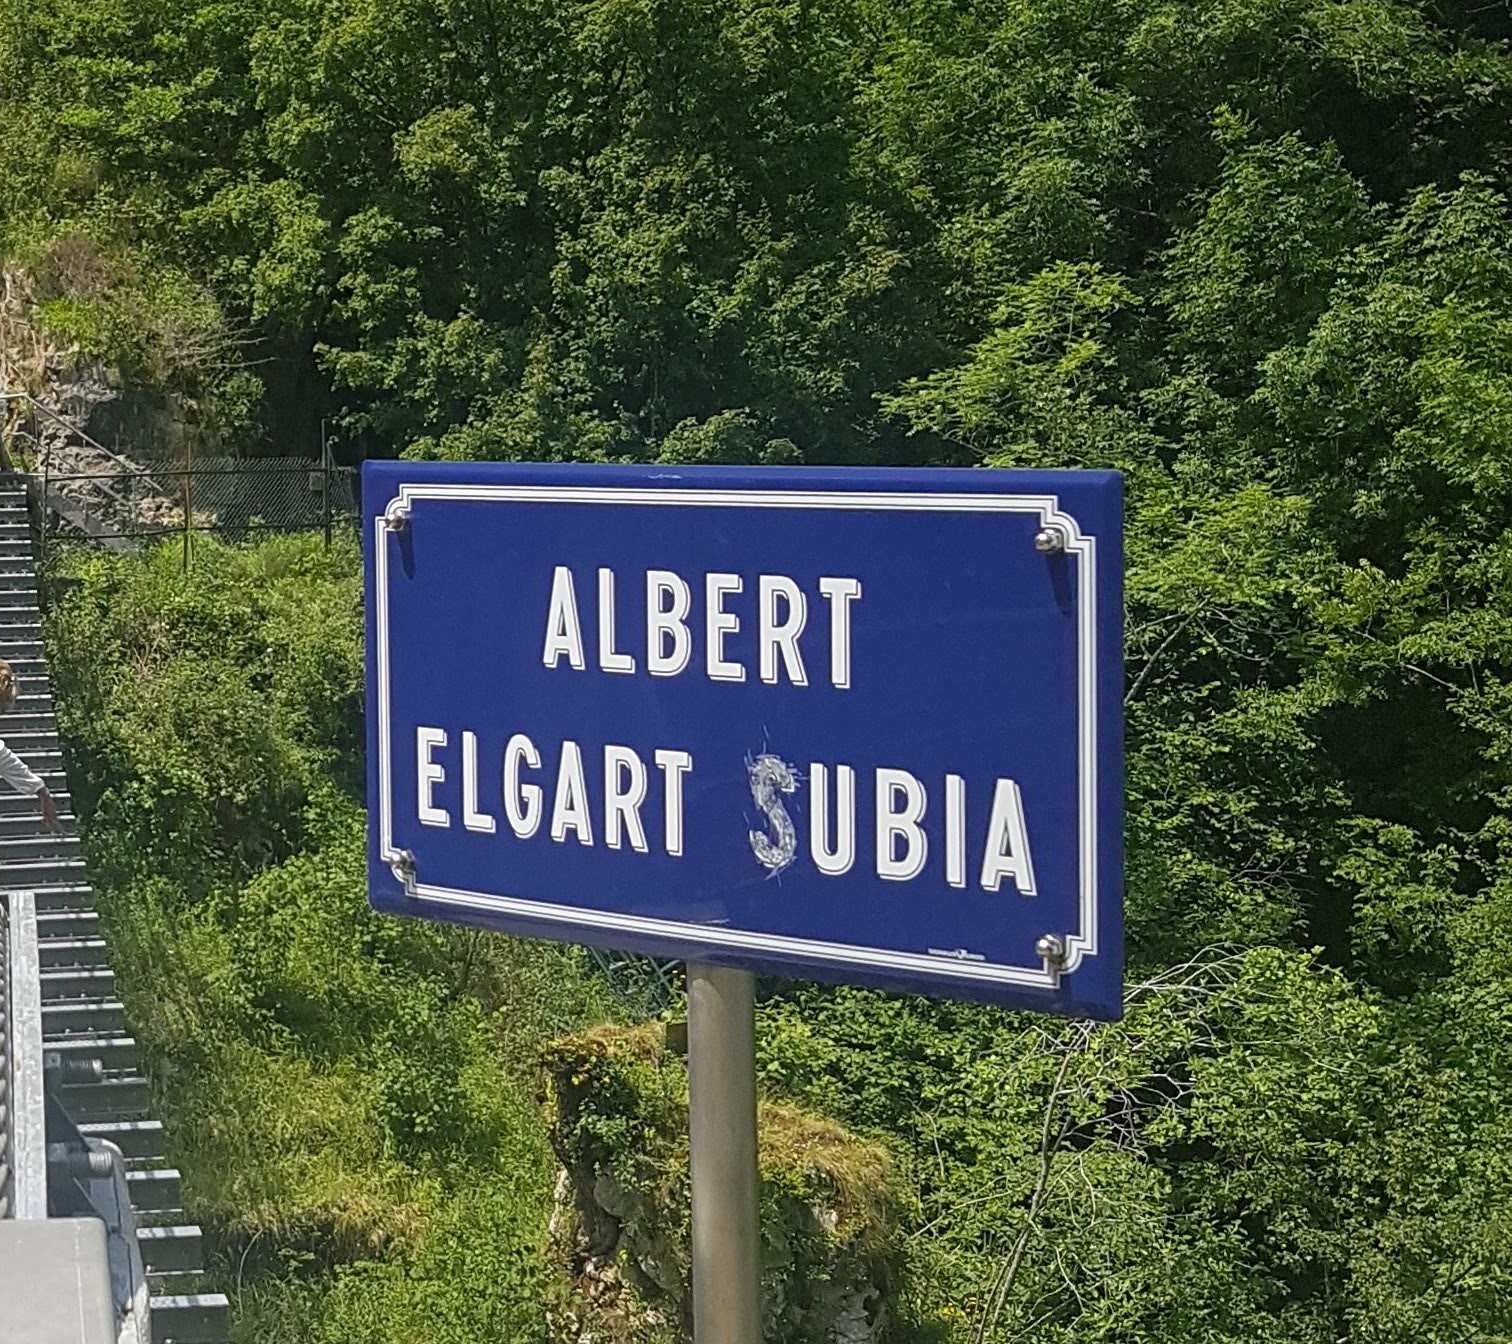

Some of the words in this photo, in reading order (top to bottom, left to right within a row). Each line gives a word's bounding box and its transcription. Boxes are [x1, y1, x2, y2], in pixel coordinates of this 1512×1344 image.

[543, 566, 862, 689] ALBERT
[417, 726, 692, 856] ELGART
[748, 755, 1037, 896] SUBIA
